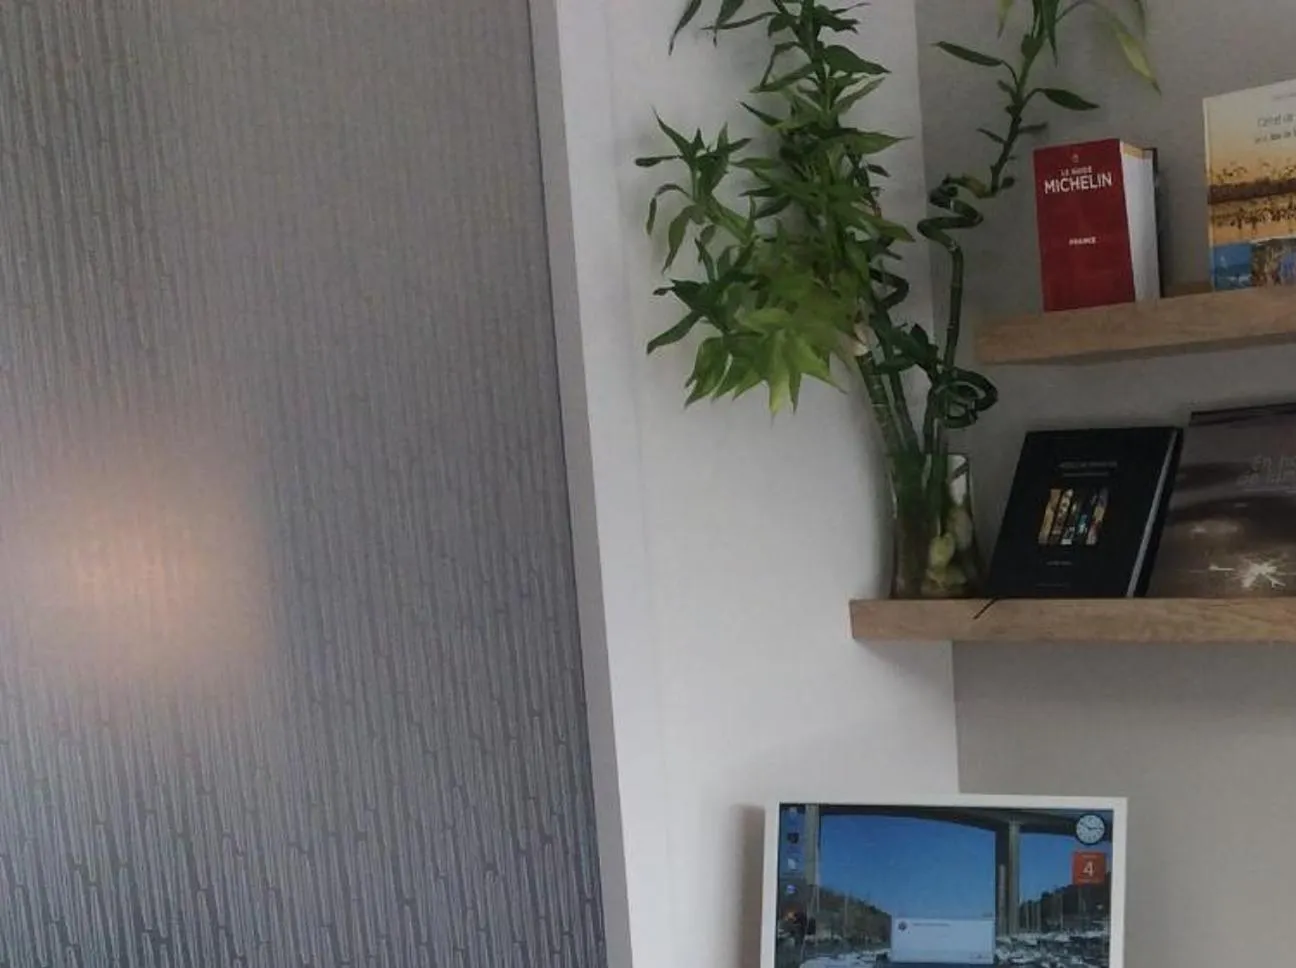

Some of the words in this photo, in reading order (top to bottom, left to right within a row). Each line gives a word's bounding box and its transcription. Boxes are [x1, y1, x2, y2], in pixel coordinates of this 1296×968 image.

[1044, 172, 1113, 194] MICHELIN
[1068, 235, 1098, 246] FRANCE
[1083, 860, 1096, 877] 4
